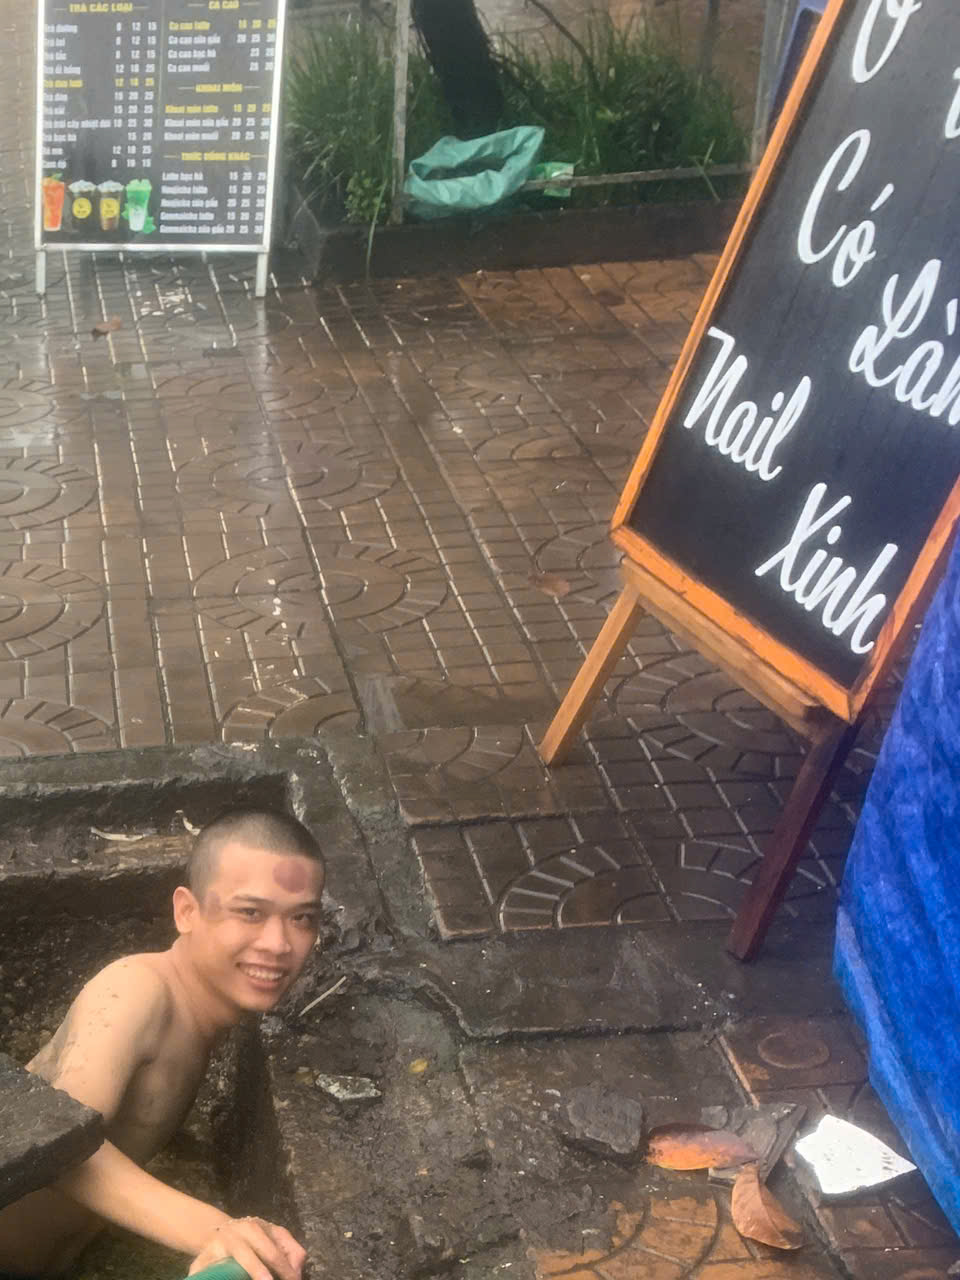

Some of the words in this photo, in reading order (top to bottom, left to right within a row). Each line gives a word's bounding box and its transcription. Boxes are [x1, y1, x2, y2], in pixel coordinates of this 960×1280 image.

[797, 129, 894, 287] Có
[684, 327, 811, 481] Nail
[755, 483, 898, 654] Xinh
